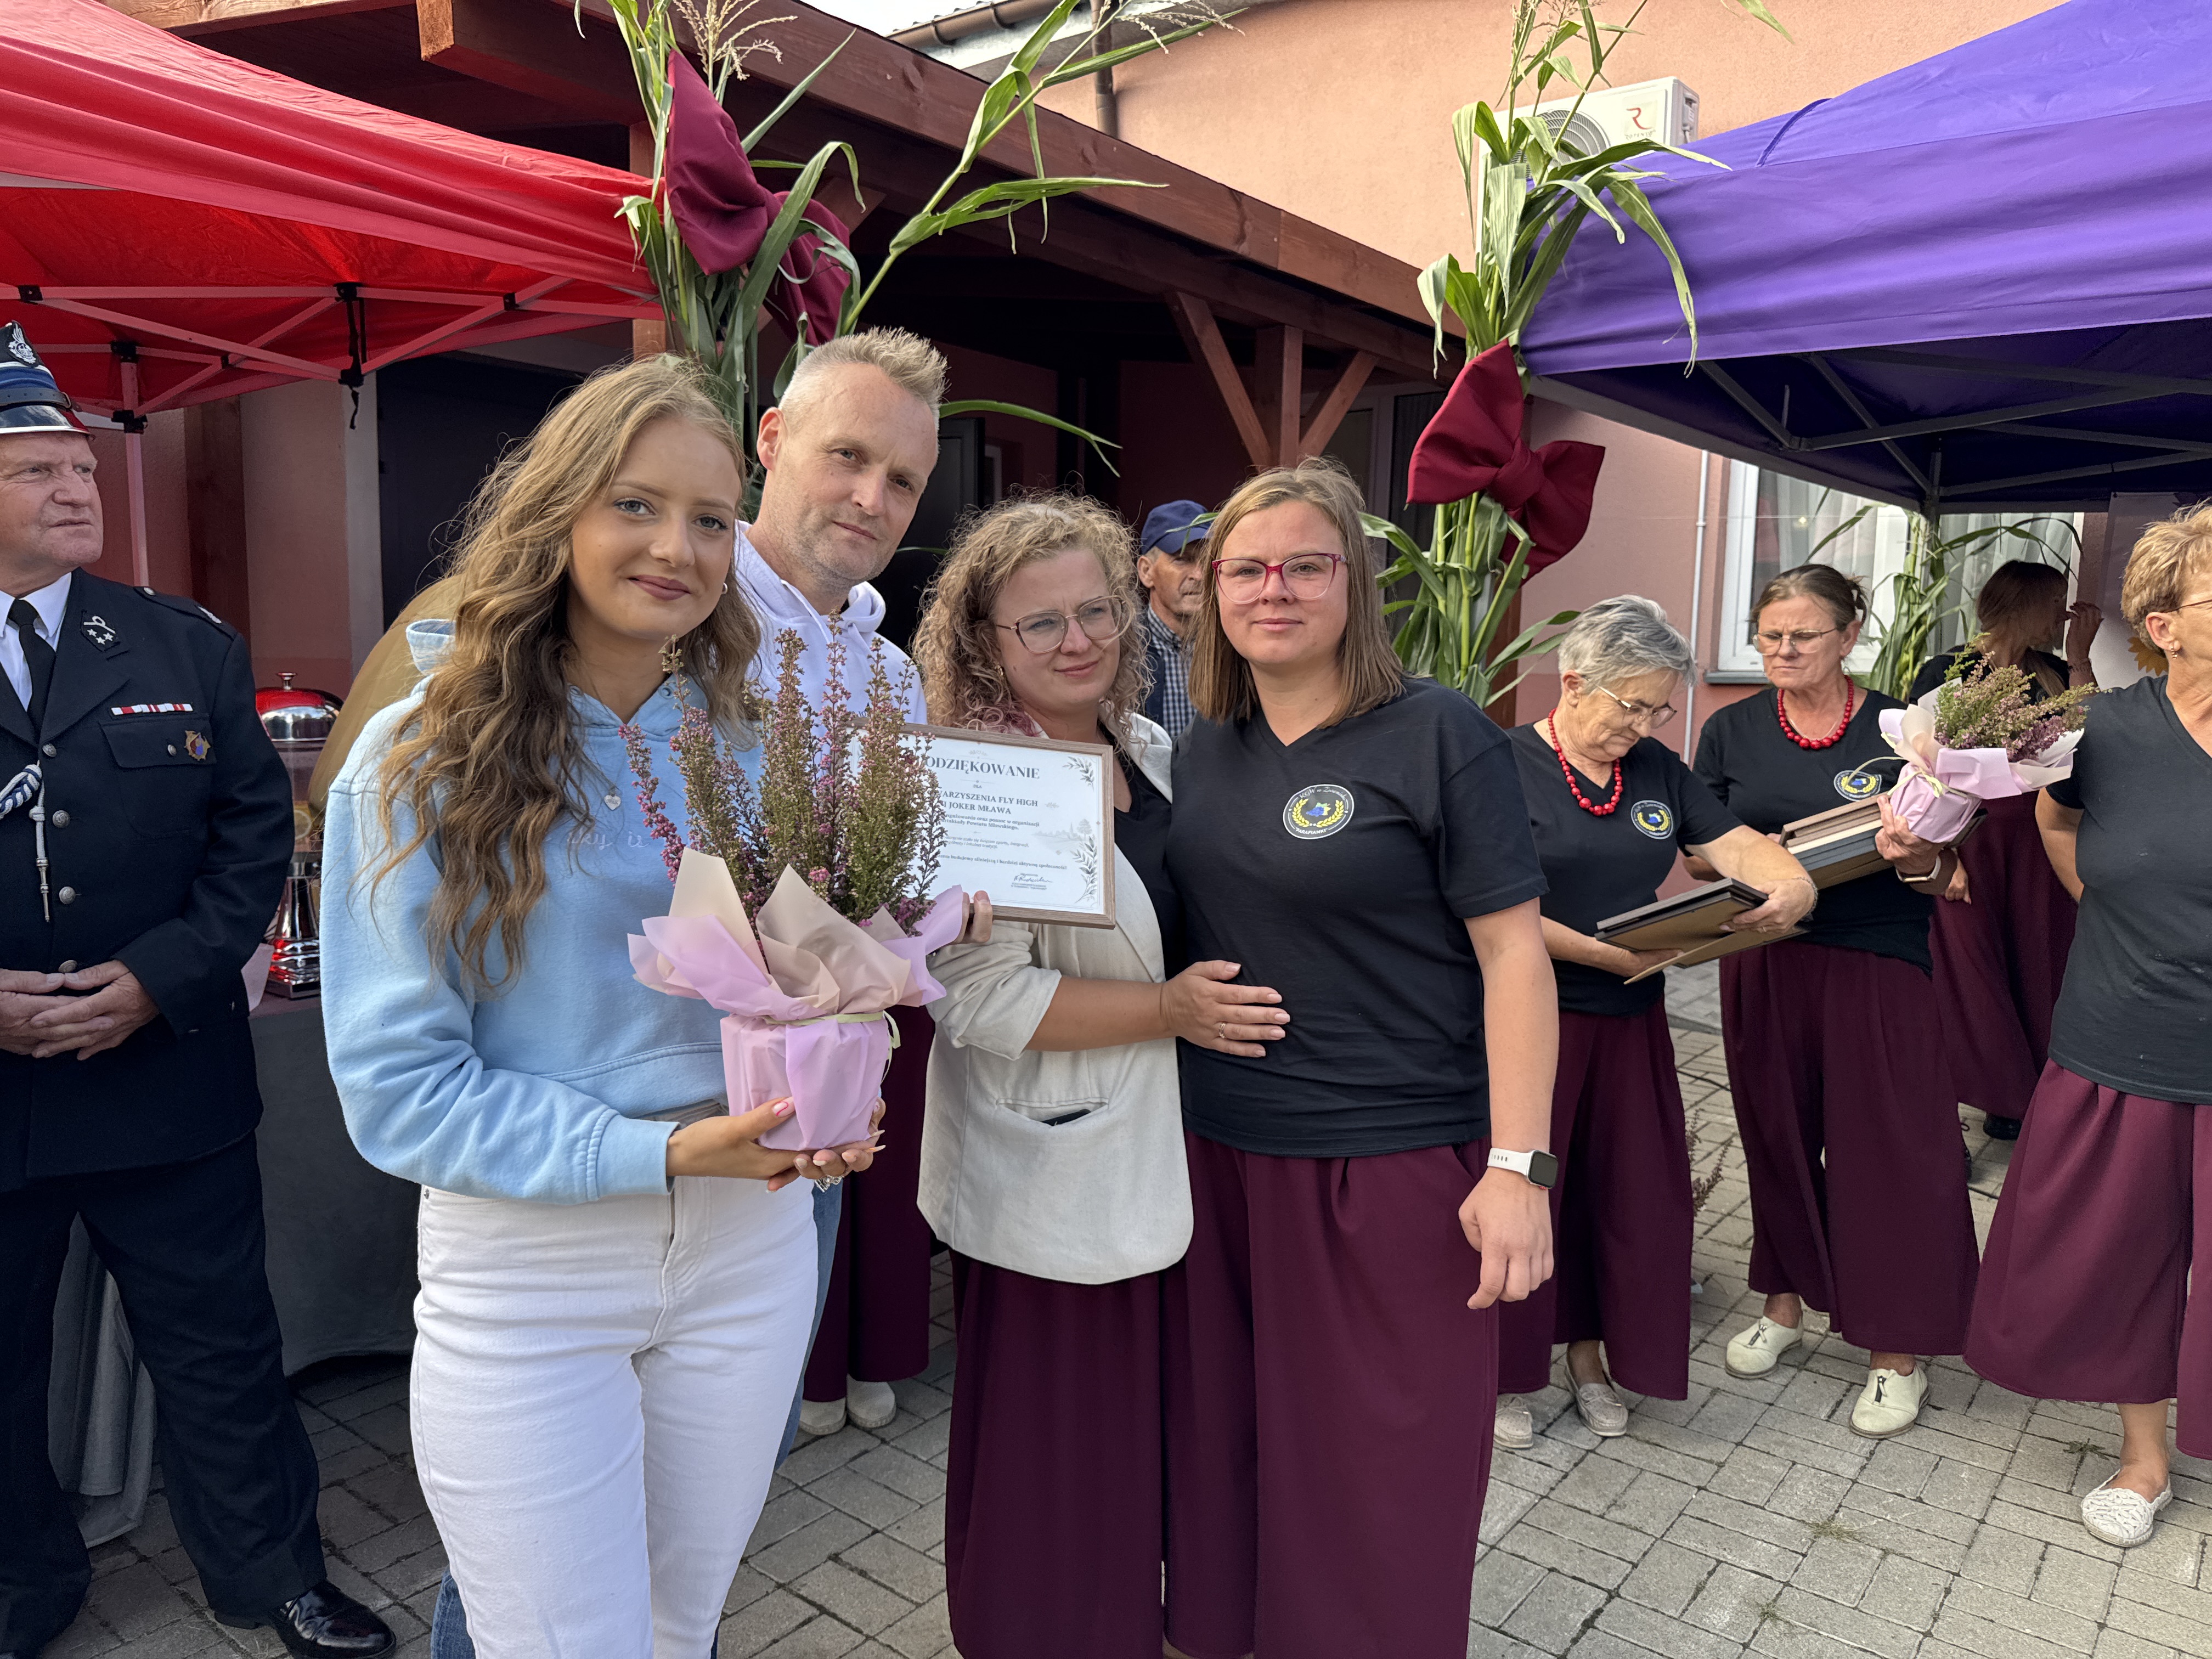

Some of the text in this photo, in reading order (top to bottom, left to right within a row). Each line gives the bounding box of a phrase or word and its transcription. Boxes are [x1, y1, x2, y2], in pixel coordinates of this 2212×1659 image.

[925, 756, 1040, 779] ODZIĘKOWANIE
[949, 802, 975, 811] JOKER
[978, 805, 1012, 815] MŁAWA
[998, 797, 1014, 805] FLY
[1016, 798, 1039, 807] HIGH
